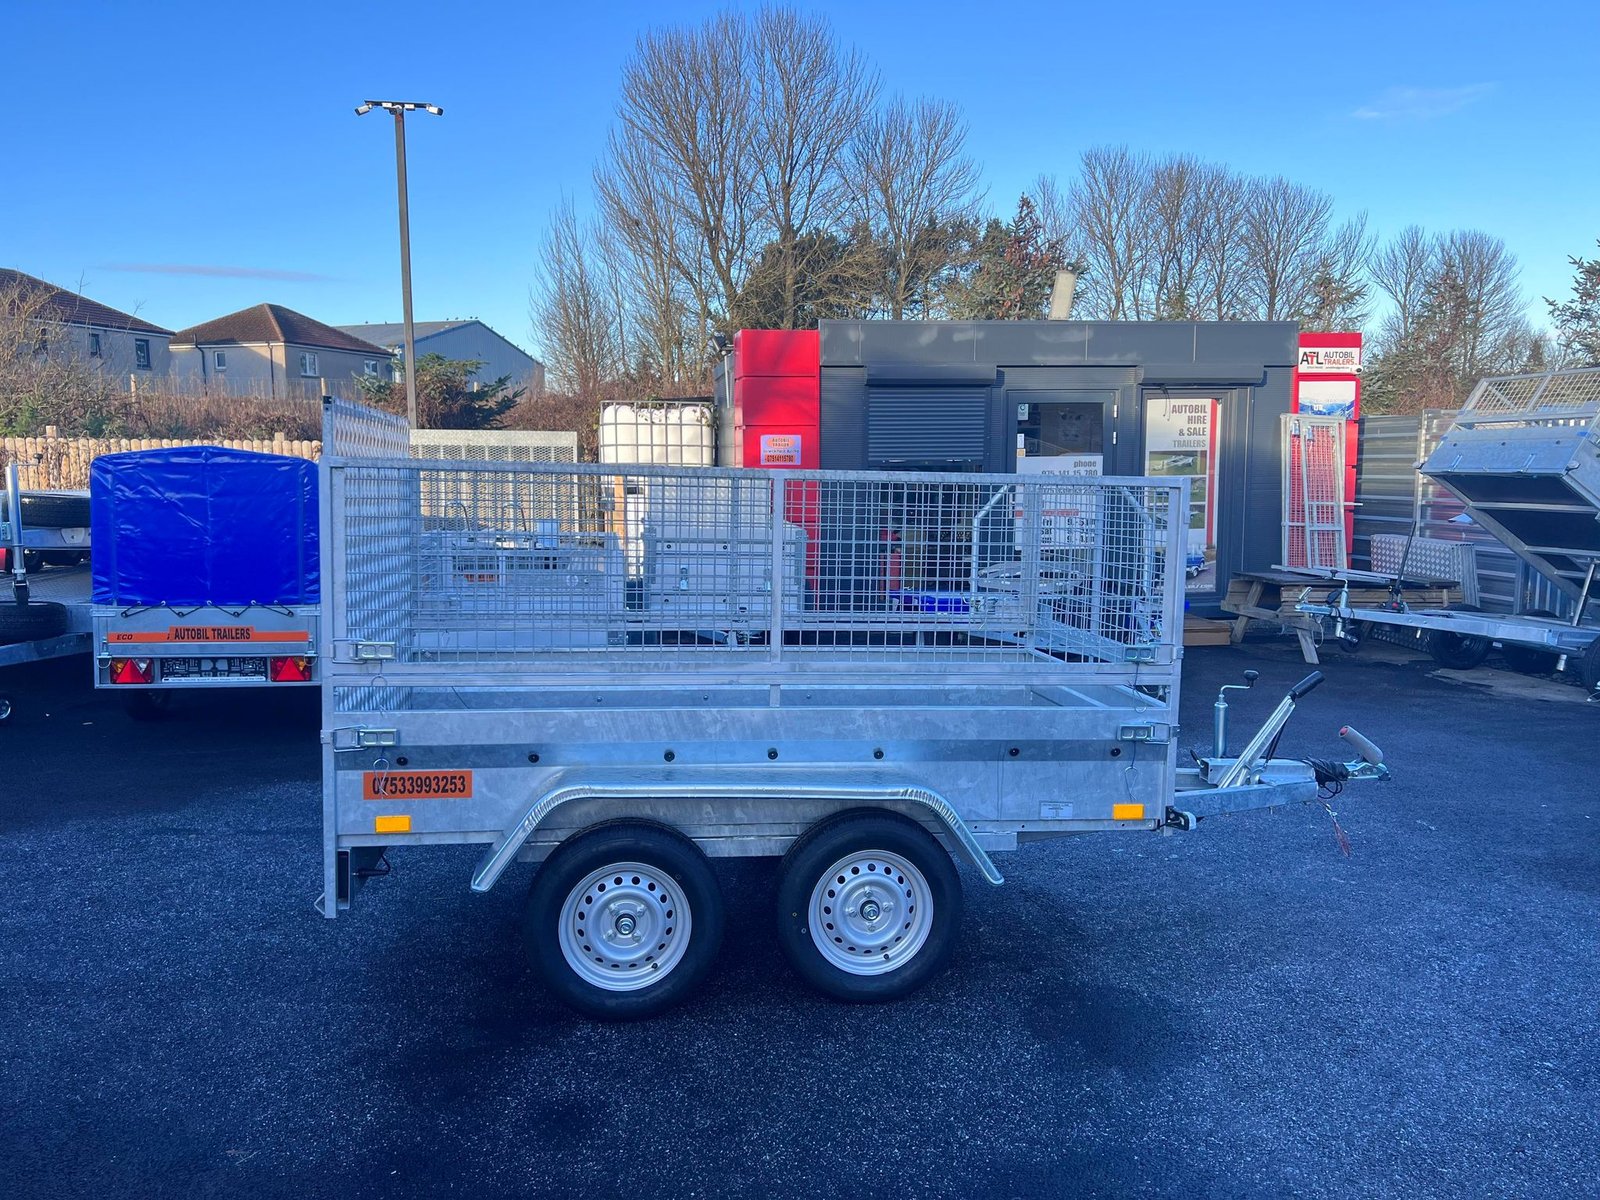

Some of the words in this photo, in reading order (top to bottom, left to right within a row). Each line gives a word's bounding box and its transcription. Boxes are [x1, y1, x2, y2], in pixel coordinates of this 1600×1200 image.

[1300, 351, 1323, 365] ATL
[1323, 351, 1355, 359] AUTOBIL
[1171, 404, 1208, 414] AUTOBIL
[1187, 415, 1208, 425] HIRE
[1178, 428, 1185, 437] &
[1186, 427, 1207, 437] SALE
[1173, 439, 1207, 448] TRAILERS
[1073, 460, 1097, 468] phone
[116, 633, 133, 641] ECO
[174, 627, 210, 641] AUTOBIL
[211, 627, 251, 640] TRAILERS
[372, 775, 466, 795] 07533993253
